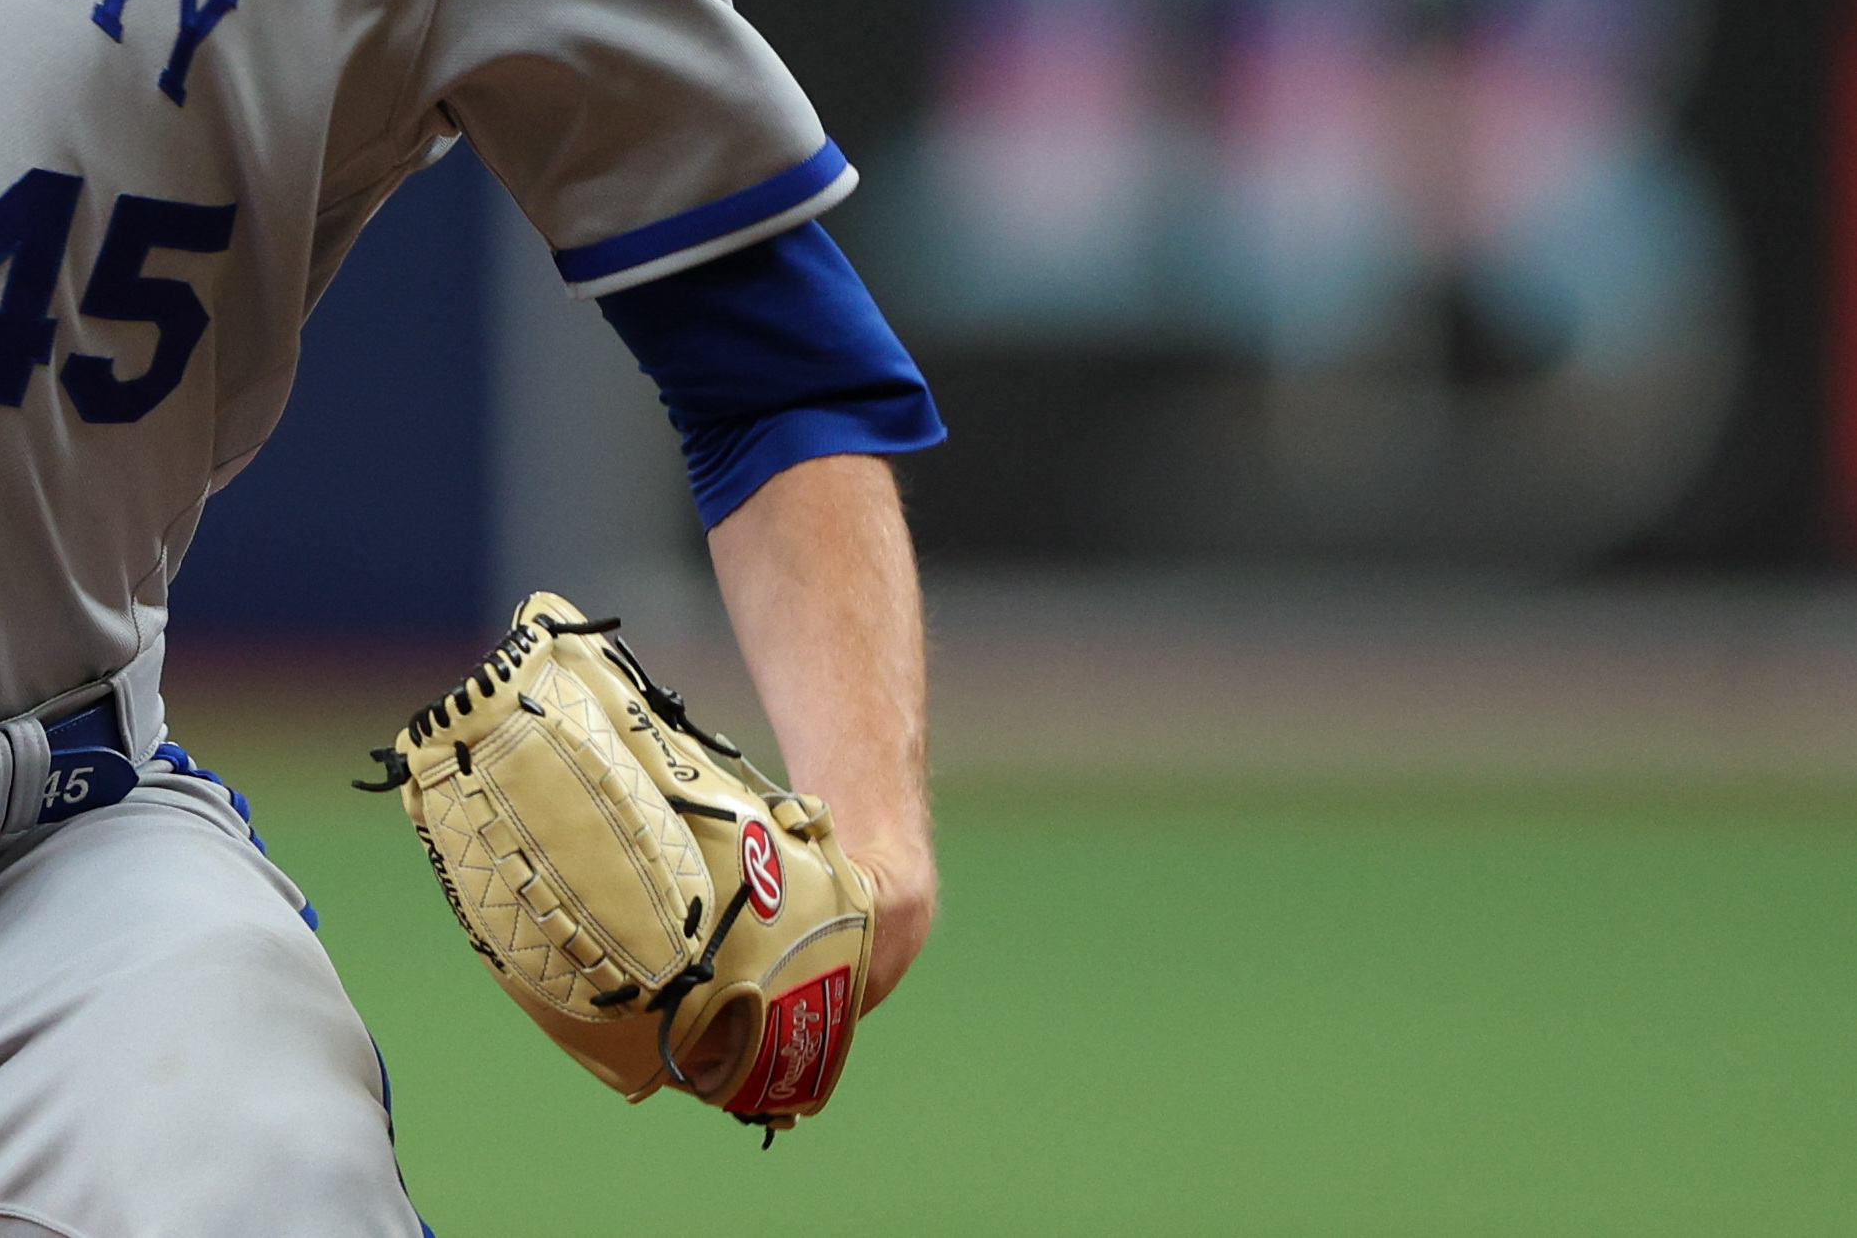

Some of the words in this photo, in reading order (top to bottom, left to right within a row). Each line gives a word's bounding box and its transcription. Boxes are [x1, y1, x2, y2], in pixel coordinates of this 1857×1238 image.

[43, 766, 94, 808] 45
[744, 831, 781, 910] R
[767, 998, 820, 1101] Rawlings
